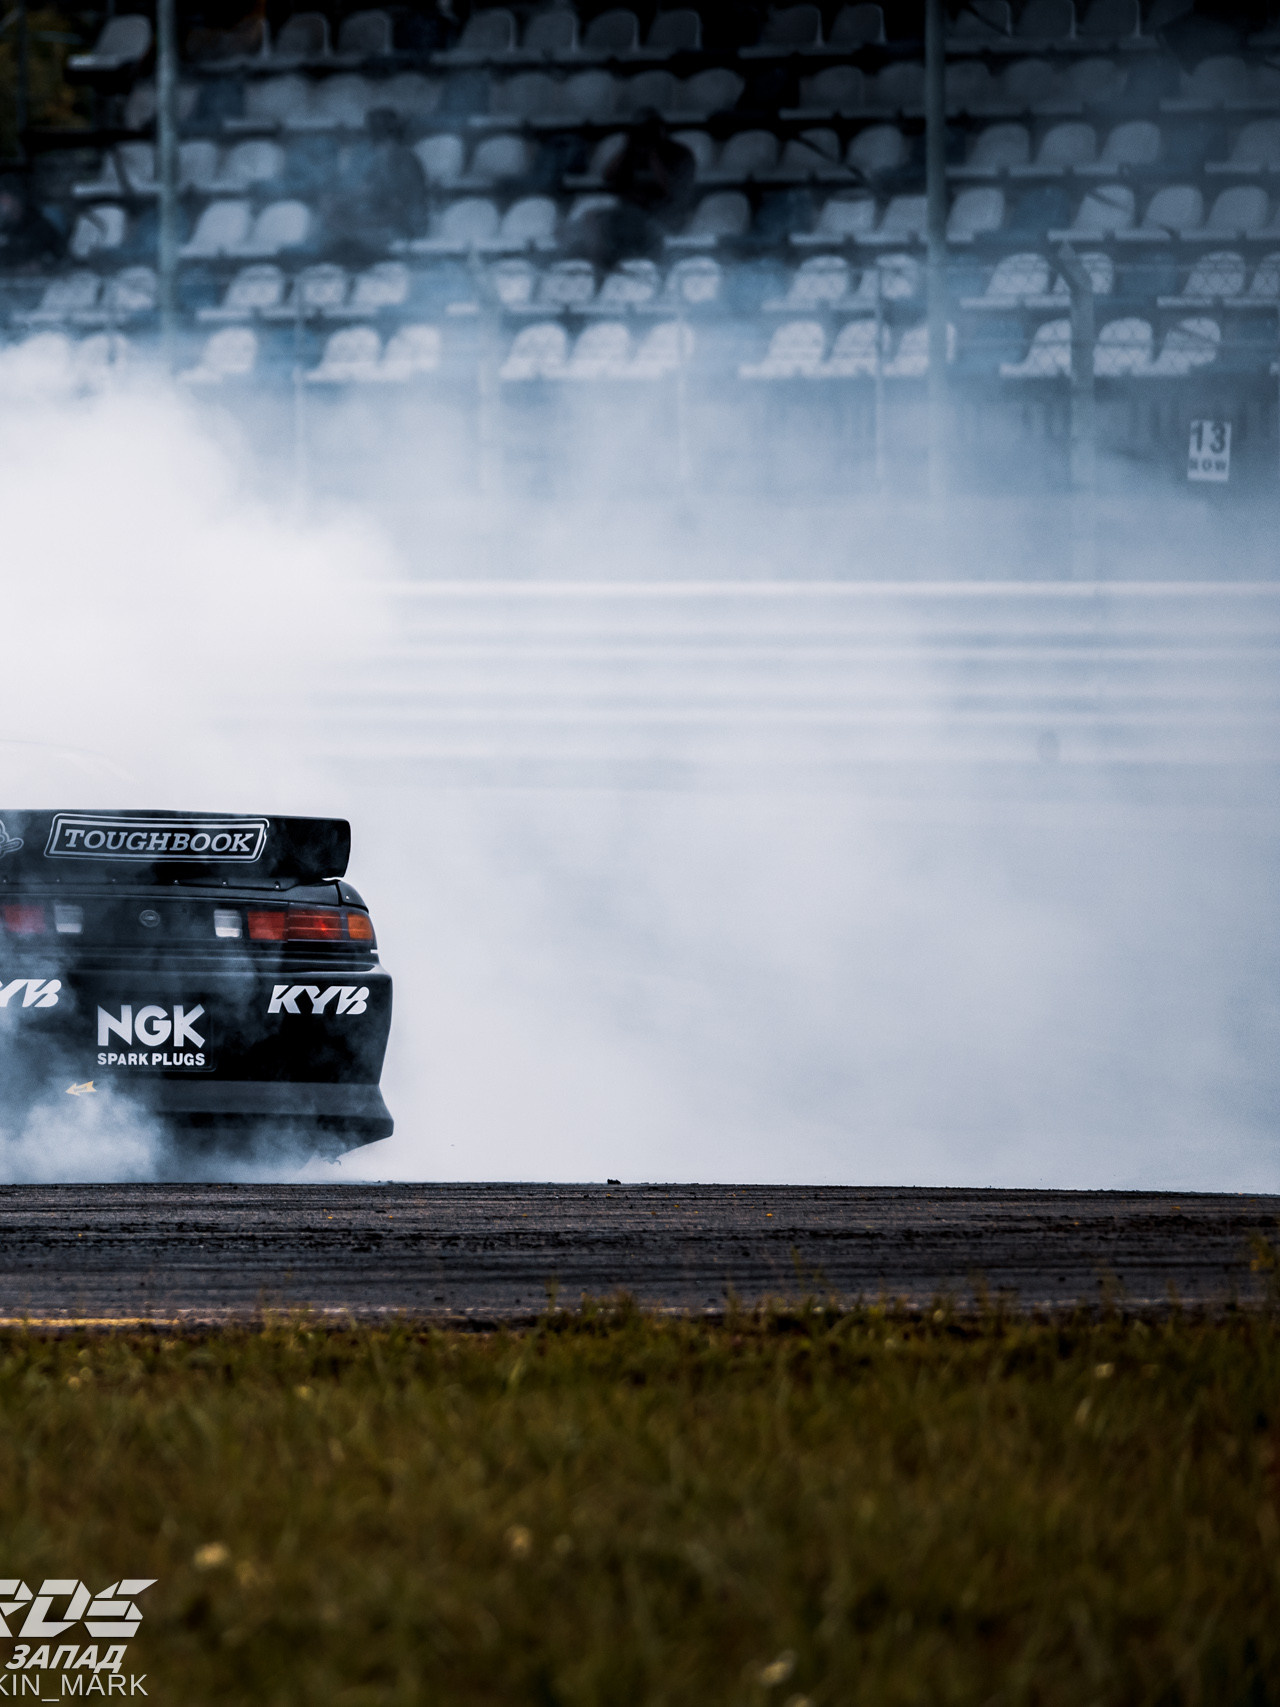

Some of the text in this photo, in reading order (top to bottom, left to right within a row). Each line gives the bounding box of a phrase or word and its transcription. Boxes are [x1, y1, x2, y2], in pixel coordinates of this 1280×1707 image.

[1191, 421, 1226, 454] 13
[64, 828, 255, 852] TOUGHBOOK
[267, 985, 371, 1015] KYB
[97, 1003, 206, 1048] NGK
[97, 1052, 206, 1066] SPARK PLUGS
